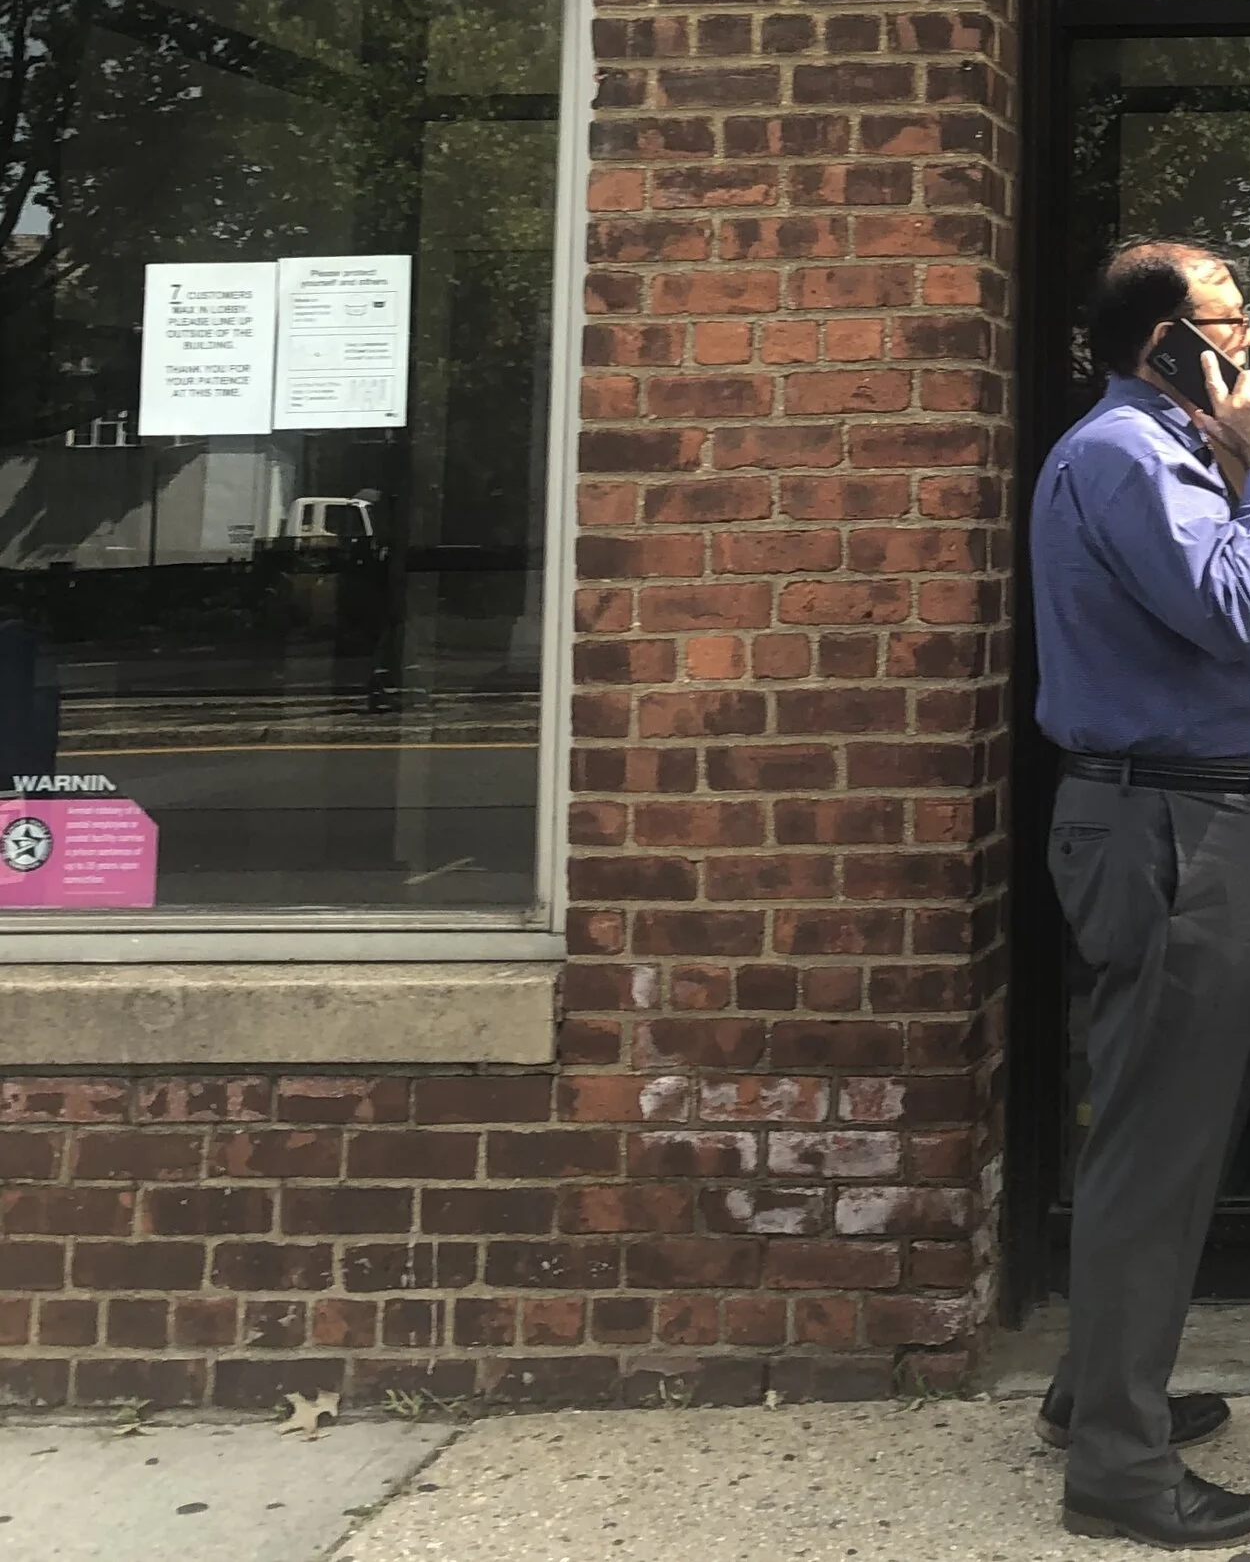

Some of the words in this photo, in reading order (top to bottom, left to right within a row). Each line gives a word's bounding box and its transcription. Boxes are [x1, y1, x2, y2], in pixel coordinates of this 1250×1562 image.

[170, 284, 183, 301] 7
[186, 290, 253, 300] CUSTOMERS
[168, 318, 210, 326] PLEASE
[212, 316, 236, 326] LINE
[239, 316, 253, 326] UP
[166, 329, 212, 338] OUTSIDE
[216, 329, 230, 338] OF
[232, 328, 254, 338] THE
[165, 366, 200, 374] THANK
[230, 364, 252, 372] FOR
[165, 378, 194, 386] YOUR
[199, 376, 250, 385] PATIENCE
[172, 388, 186, 398] AT
[188, 388, 212, 397] THIS
